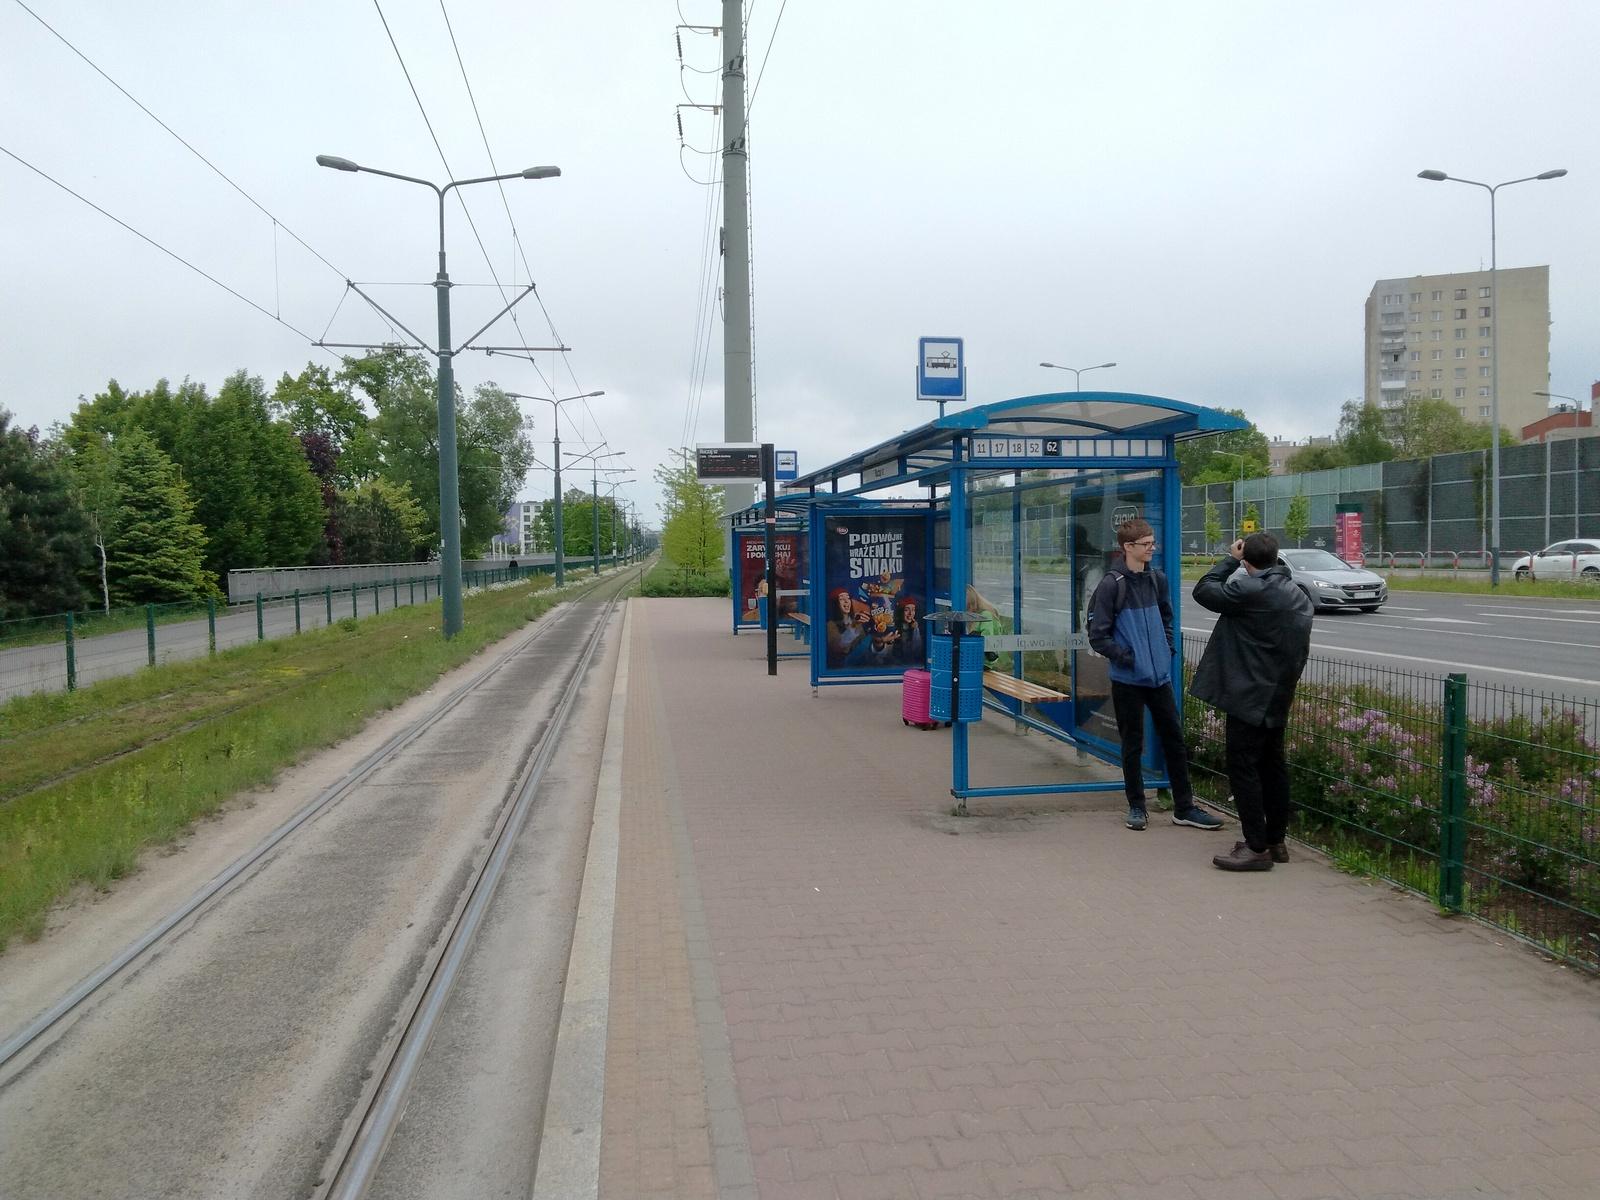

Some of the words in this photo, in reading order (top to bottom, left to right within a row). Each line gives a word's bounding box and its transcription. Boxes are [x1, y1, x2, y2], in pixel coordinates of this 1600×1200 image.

[977, 443, 986, 454] 11
[995, 443, 1004, 453] 17
[1013, 443, 1022, 453] 18
[1030, 443, 1039, 453] 52
[1047, 441, 1057, 452] 62
[849, 532, 903, 547] PODWÓJNE
[849, 541, 903, 558] WRAŻENIE
[849, 558, 903, 579] SMAKU
